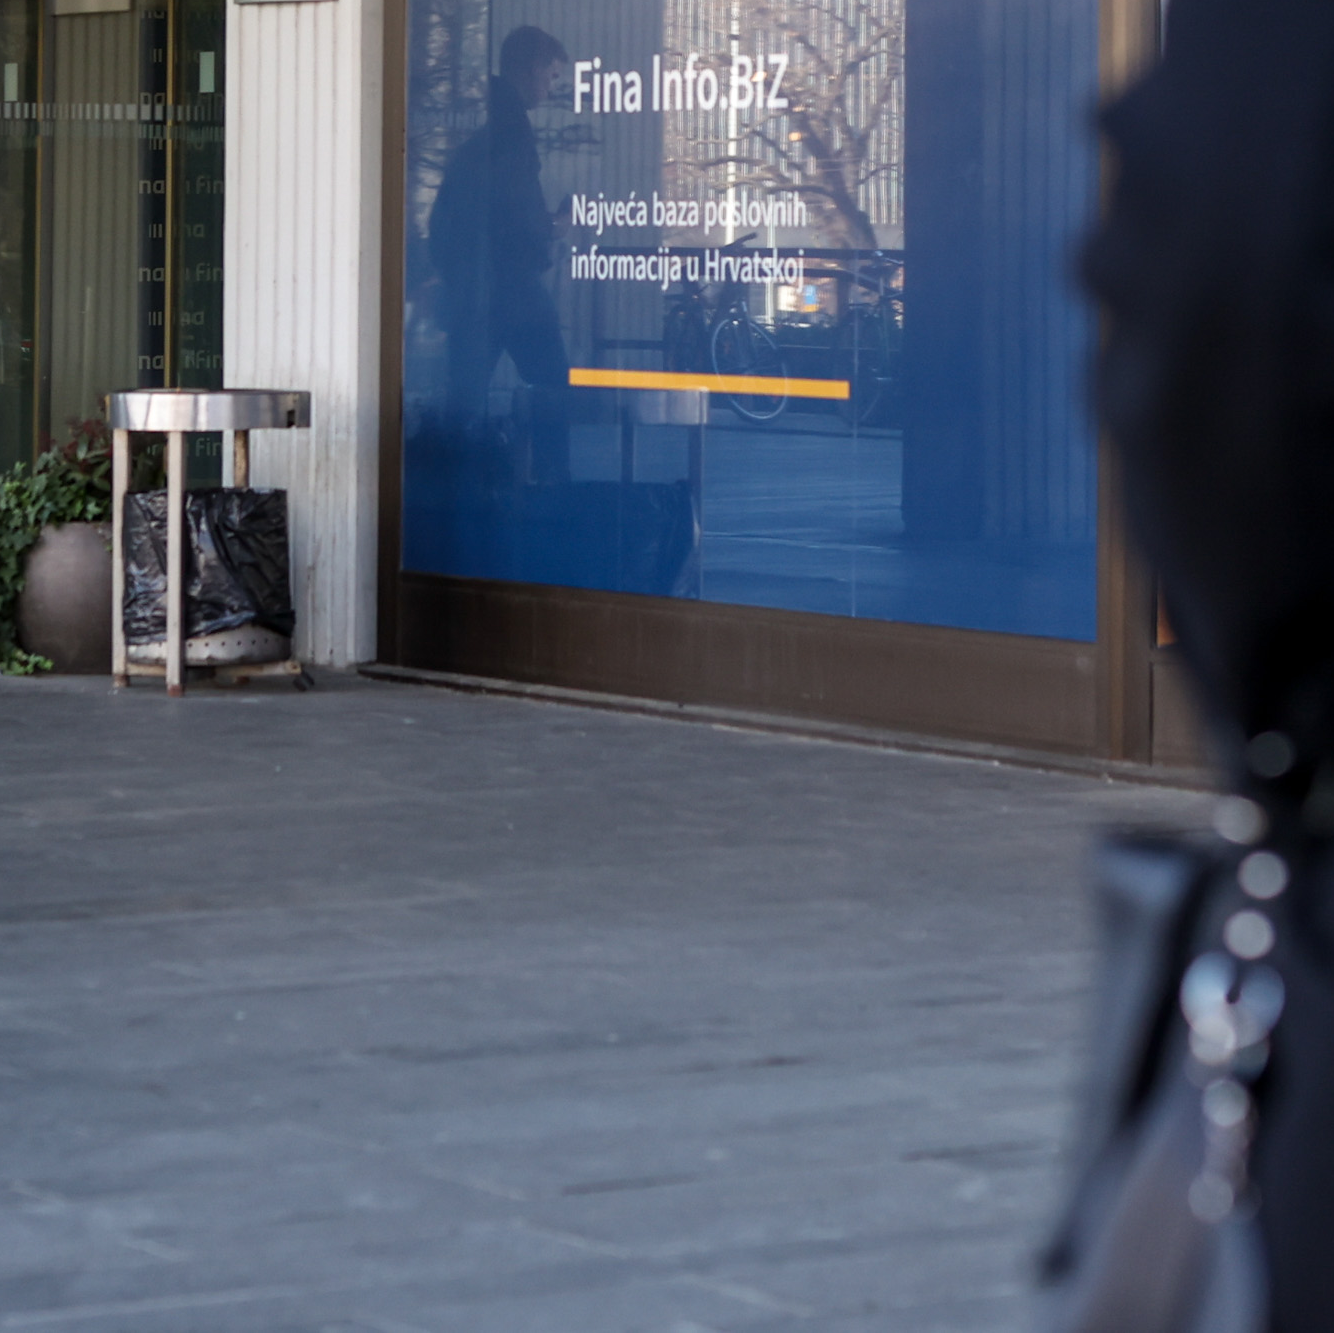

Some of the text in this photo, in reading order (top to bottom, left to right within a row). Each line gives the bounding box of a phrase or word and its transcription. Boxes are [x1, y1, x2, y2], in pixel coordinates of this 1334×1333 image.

[574, 52, 789, 114] Fina Info.BIZ
[571, 190, 807, 236] Najveća baza poslovnih
[571, 244, 805, 293] informacija u Hrvatskoj
